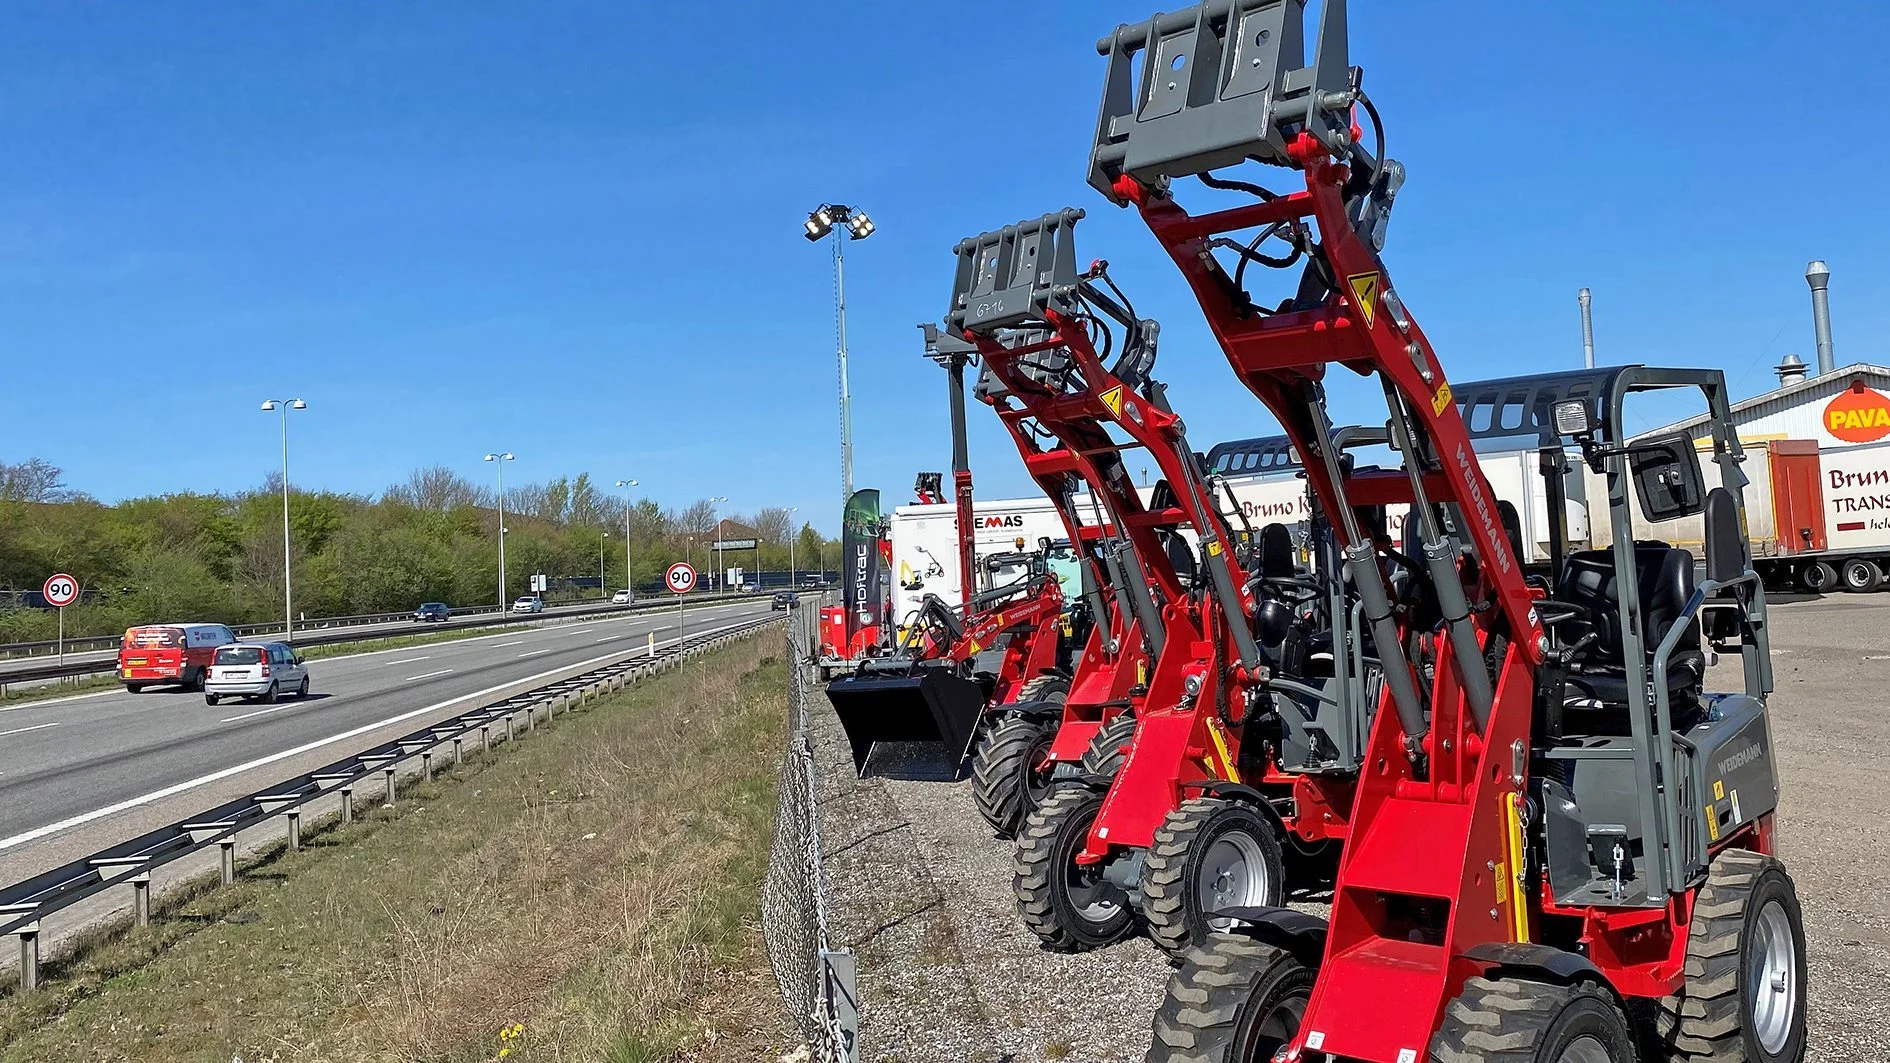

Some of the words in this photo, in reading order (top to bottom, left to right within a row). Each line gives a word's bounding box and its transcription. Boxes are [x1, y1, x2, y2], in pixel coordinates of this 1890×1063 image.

[1242, 501, 1294, 518] Bruno
[1456, 442, 1511, 574] WEIDEMANN
[954, 515, 1023, 529] EMAS
[672, 571, 691, 584] 90
[50, 583, 72, 597] 90
[1717, 742, 1762, 775] WEIDEMANN
